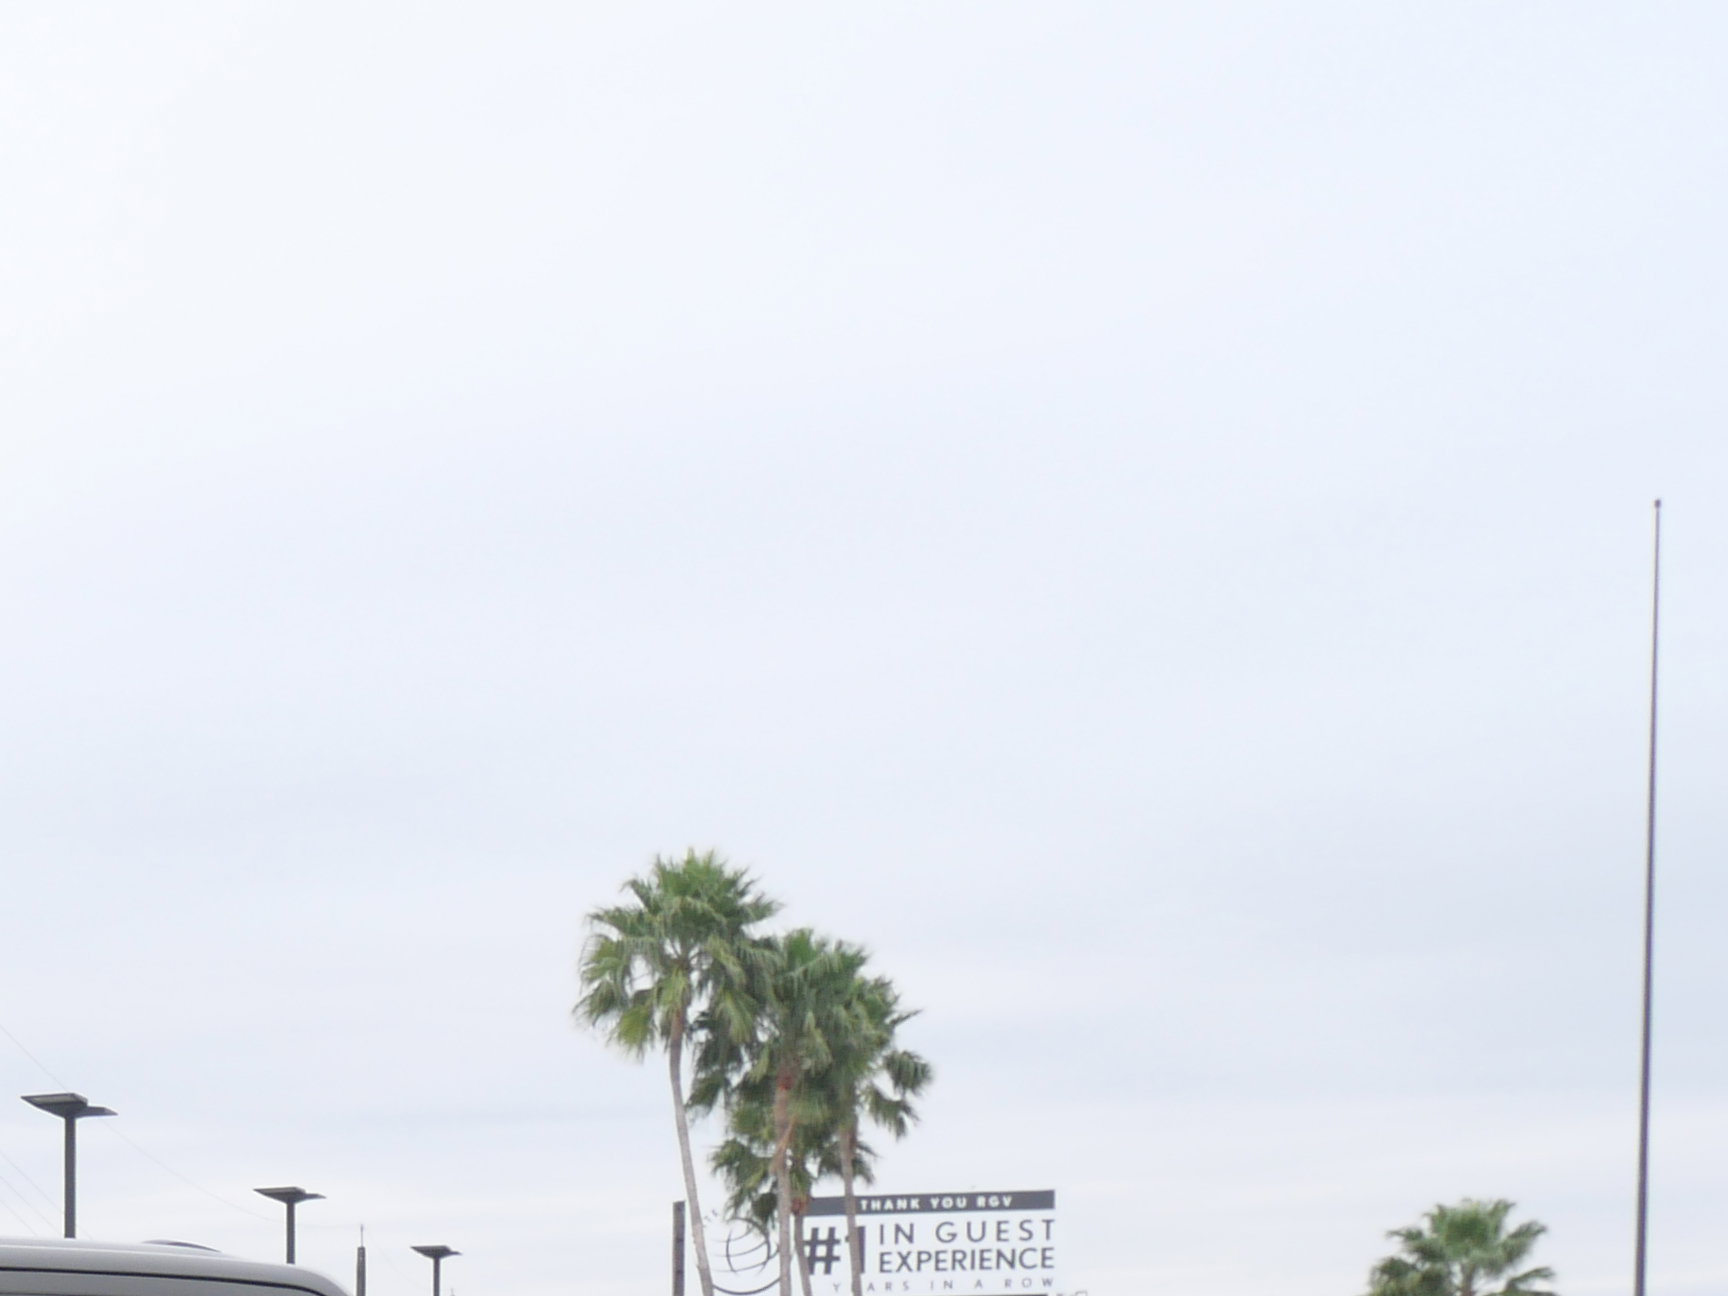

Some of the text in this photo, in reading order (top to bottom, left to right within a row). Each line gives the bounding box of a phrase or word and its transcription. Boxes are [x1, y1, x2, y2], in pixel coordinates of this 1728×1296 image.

[859, 1195, 1013, 1211] THANK YOU RGV
[879, 1219, 1055, 1245] IN GUEST
[879, 1246, 1055, 1274] EXPERIENCE
[832, 1277, 1054, 1293] YARS IN A ROW
